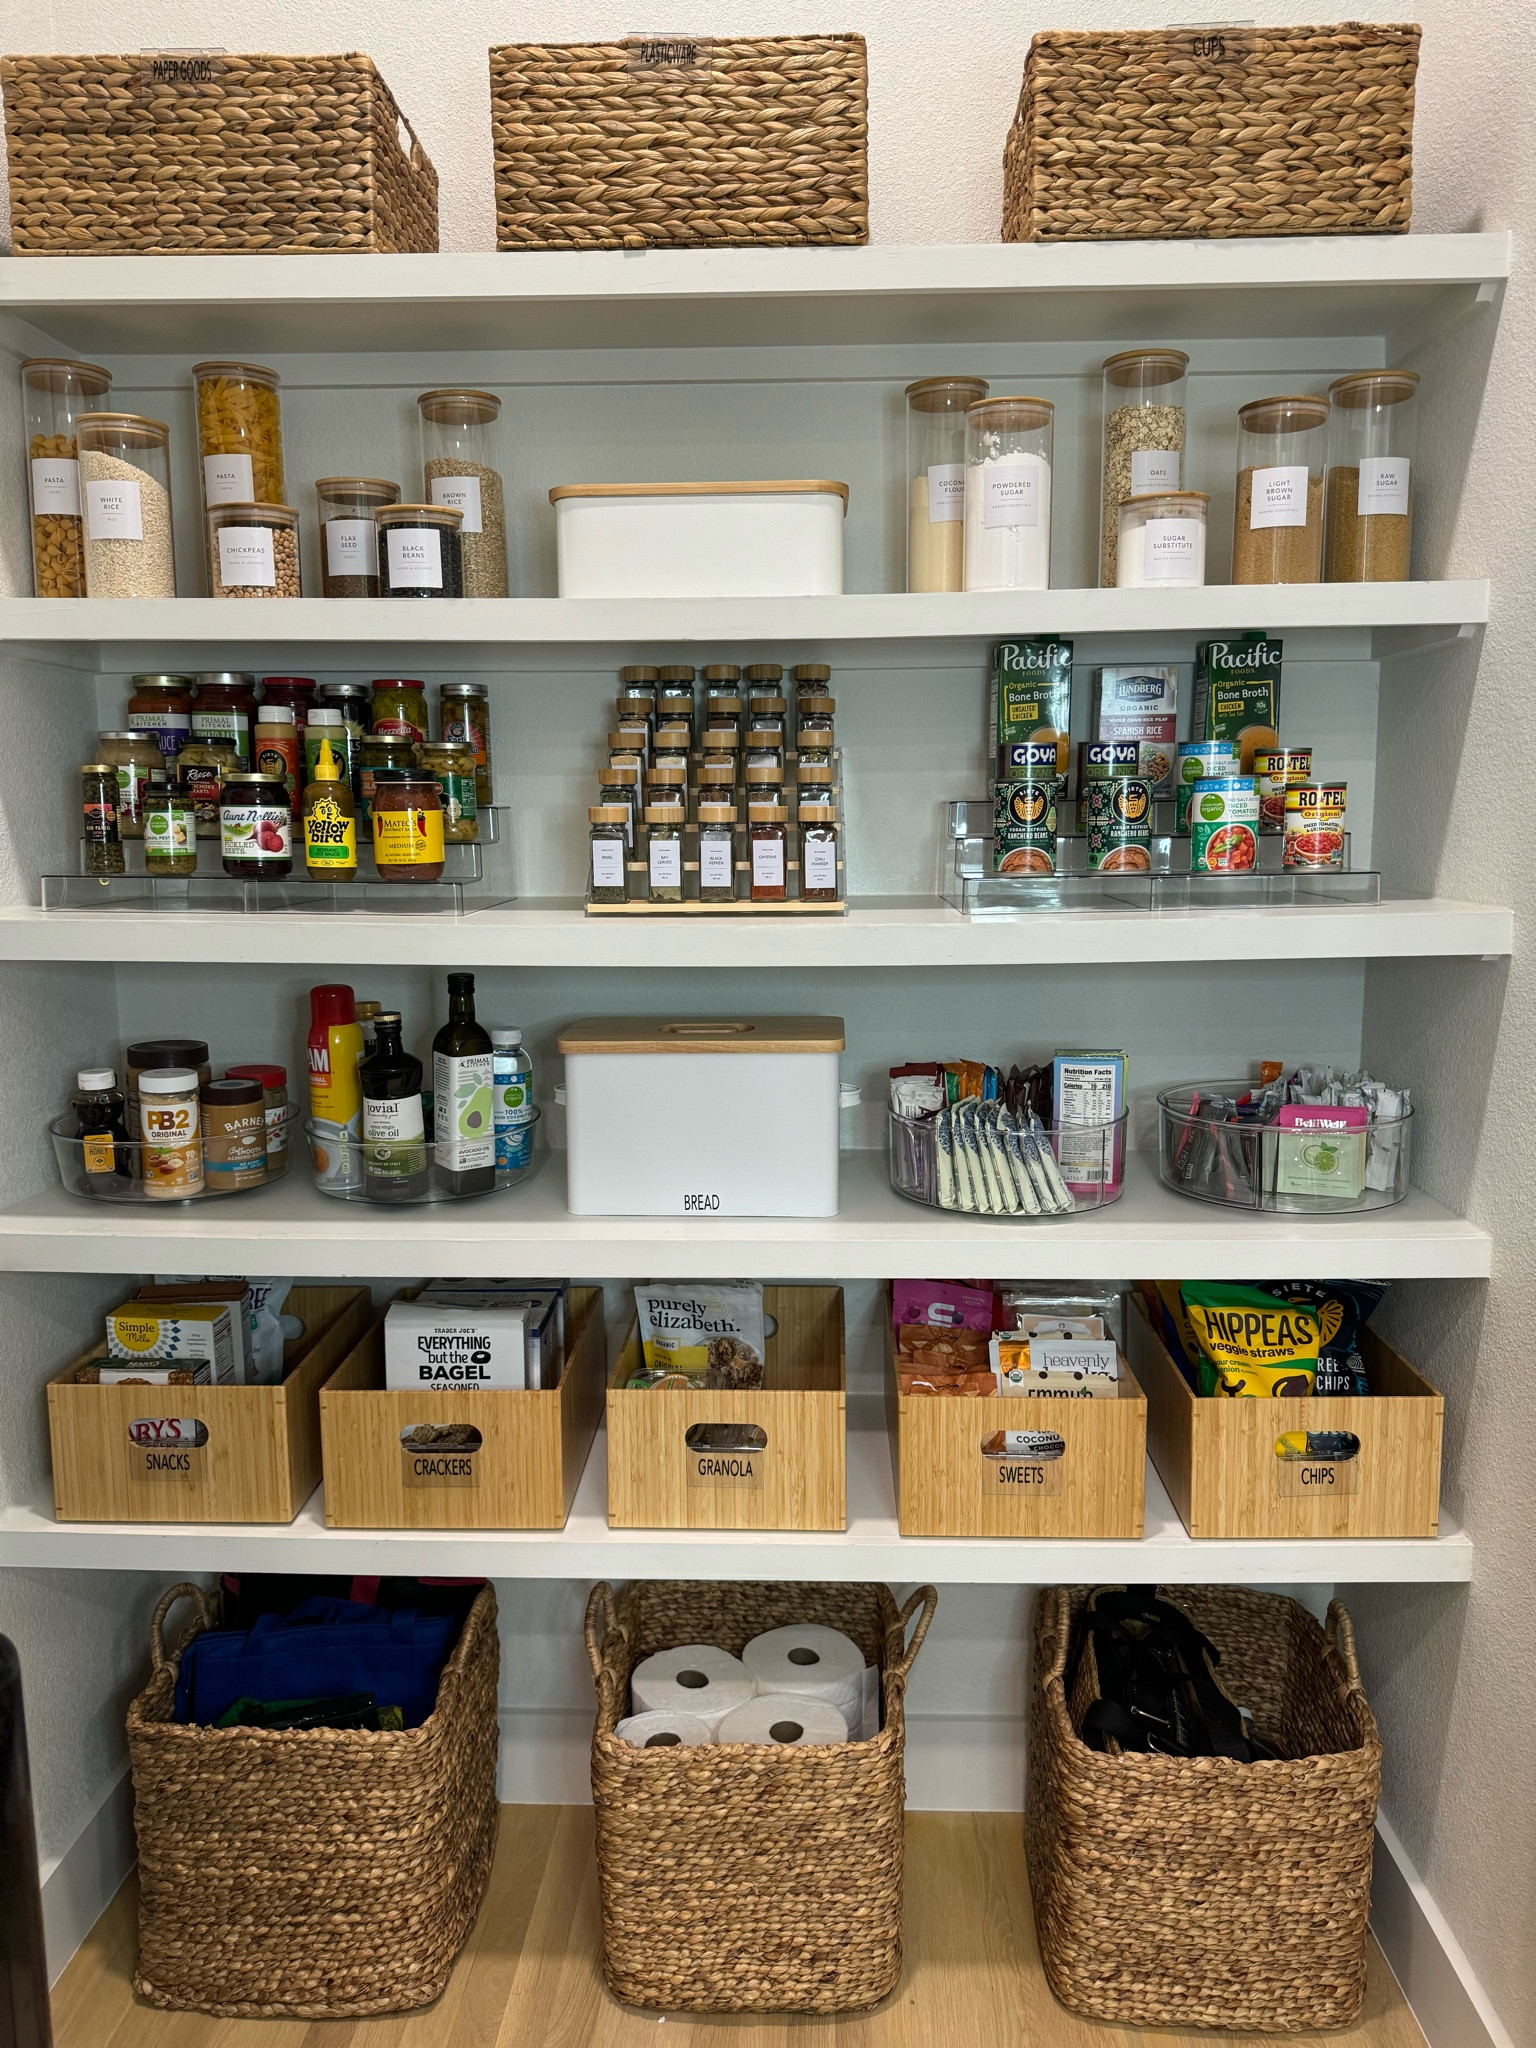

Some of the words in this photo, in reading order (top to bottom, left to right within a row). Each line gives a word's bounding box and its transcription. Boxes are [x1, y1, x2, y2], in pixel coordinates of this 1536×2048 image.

[641, 42, 697, 65] PLASTICWARE
[1194, 36, 1226, 57] CUPS
[153, 60, 178, 81] PAPER
[180, 60, 212, 81] GOODS
[1266, 487, 1293, 495] BROWN
[1000, 644, 1073, 672] Pacific
[1209, 642, 1282, 670] Pacific
[1009, 681, 1037, 691] Organic
[1120, 684, 1162, 696] LUNDBERG
[1218, 680, 1246, 689] Organic
[1010, 692, 1032, 702] Bone
[1218, 691, 1240, 700] Bone
[1242, 687, 1269, 698] Broth
[1012, 712, 1033, 720] CHICKEN
[379, 726, 412, 736] Mezzetta
[1114, 726, 1144, 736] SPANISH
[1146, 726, 1163, 735] RICE
[1013, 748, 1056, 764] GOYA
[1090, 747, 1136, 762] GOYA
[1019, 788, 1040, 796] SIETE
[223, 810, 246, 821] Aunt
[247, 810, 284, 821] Nellie's
[308, 820, 350, 834] Yellow
[311, 830, 344, 843] bird
[467, 1057, 490, 1065] PRIMAL
[367, 1101, 399, 1116] jovial
[147, 1110, 190, 1130] PB2
[224, 1117, 265, 1132] BARNEY
[152, 1130, 188, 1138] ORIGINAL
[368, 1129, 386, 1137] olive
[388, 1129, 399, 1137] oil
[459, 1147, 482, 1155] AVOCADO
[684, 1195, 720, 1211] BREAD
[1272, 1282, 1327, 1299] SIETE
[648, 1299, 707, 1318] purely
[119, 1322, 155, 1333] Simple
[1204, 1309, 1314, 1347] HIPPEAS
[126, 1333, 151, 1343] Mills
[418, 1336, 491, 1352] EVERYTHING
[1210, 1342, 1249, 1356] veggie
[1250, 1346, 1295, 1358] straws
[429, 1351, 449, 1364] but
[450, 1351, 468, 1364] the
[1043, 1352, 1110, 1369] heavenly
[420, 1366, 491, 1380] BAGEL
[1316, 1376, 1350, 1390] CHIPS
[146, 1454, 190, 1471] SNACKS
[414, 1459, 472, 1476] CRACKERS
[698, 1459, 753, 1477] GRANOLA
[1000, 1466, 1044, 1484] SWEETS
[1302, 1468, 1335, 1485] CHIPS
